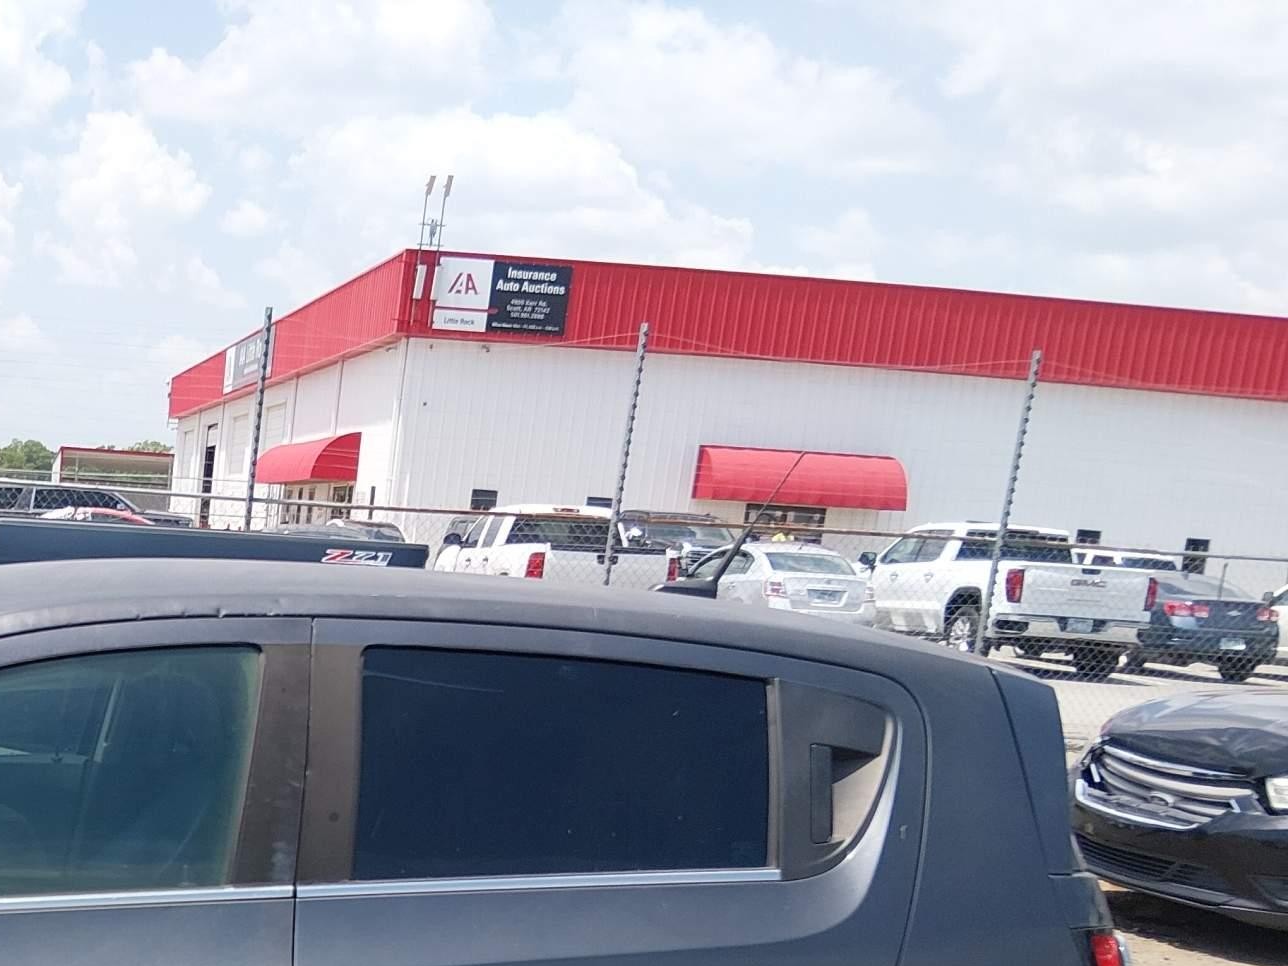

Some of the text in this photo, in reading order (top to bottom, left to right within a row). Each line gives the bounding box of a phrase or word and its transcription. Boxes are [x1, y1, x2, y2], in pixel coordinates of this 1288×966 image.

[507, 267, 557, 281] Insurance
[496, 280, 565, 295] Auto Auctions
[321, 549, 392, 566] Z71
